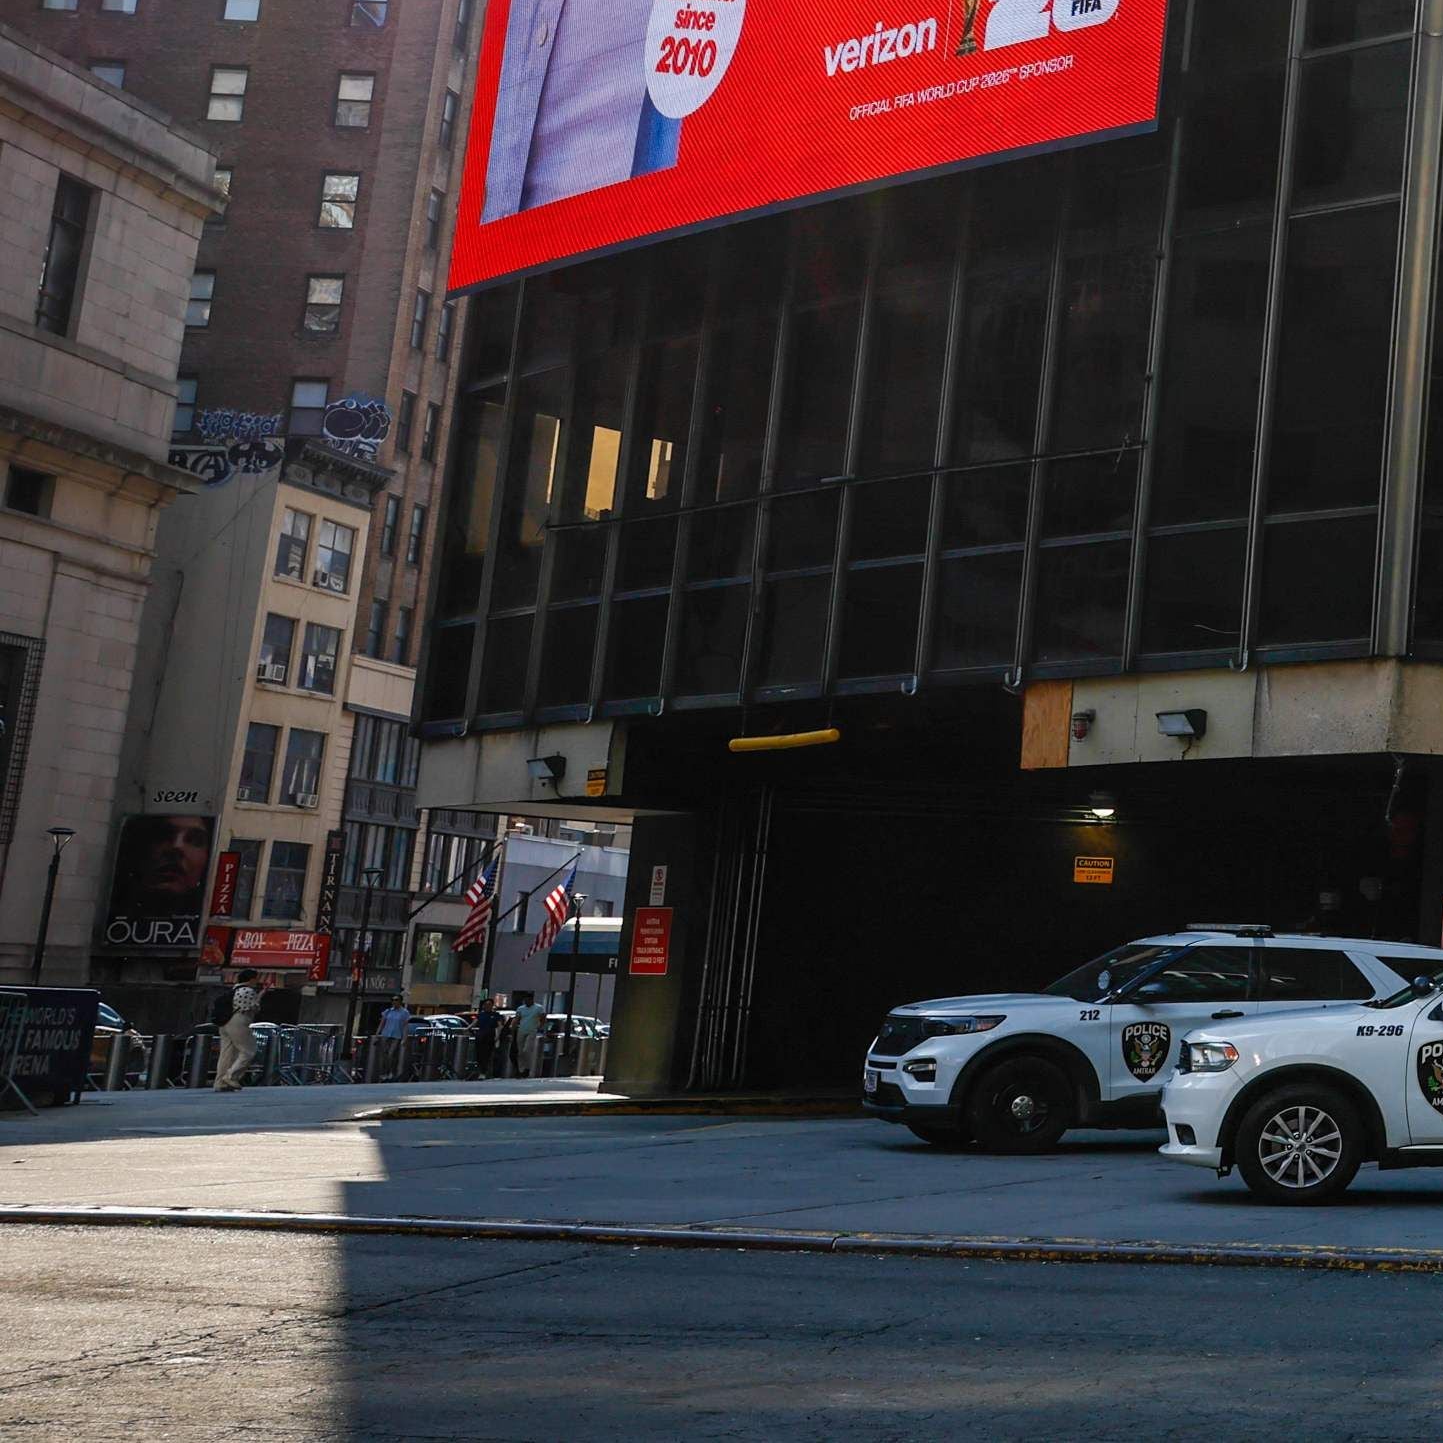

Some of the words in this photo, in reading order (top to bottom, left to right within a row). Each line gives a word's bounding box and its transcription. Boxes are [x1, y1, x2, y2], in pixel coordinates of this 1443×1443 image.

[675, 3, 716, 31] since
[655, 36, 717, 77] 2010
[824, 15, 937, 77] verizon
[849, 99, 893, 120] OFFICIAL
[894, 93, 914, 109] FIFA
[917, 83, 955, 103] WORLD
[956, 77, 980, 95] CUP
[1018, 55, 1073, 80] SPONSOR
[153, 788, 198, 803] seen
[216, 863, 235, 914] PIZZA
[1079, 1009, 1100, 1021] 212
[1125, 1023, 1168, 1042] POLICE
[1356, 1025, 1404, 1036] K9-296
[1133, 1067, 1157, 1076] AMTRAK
